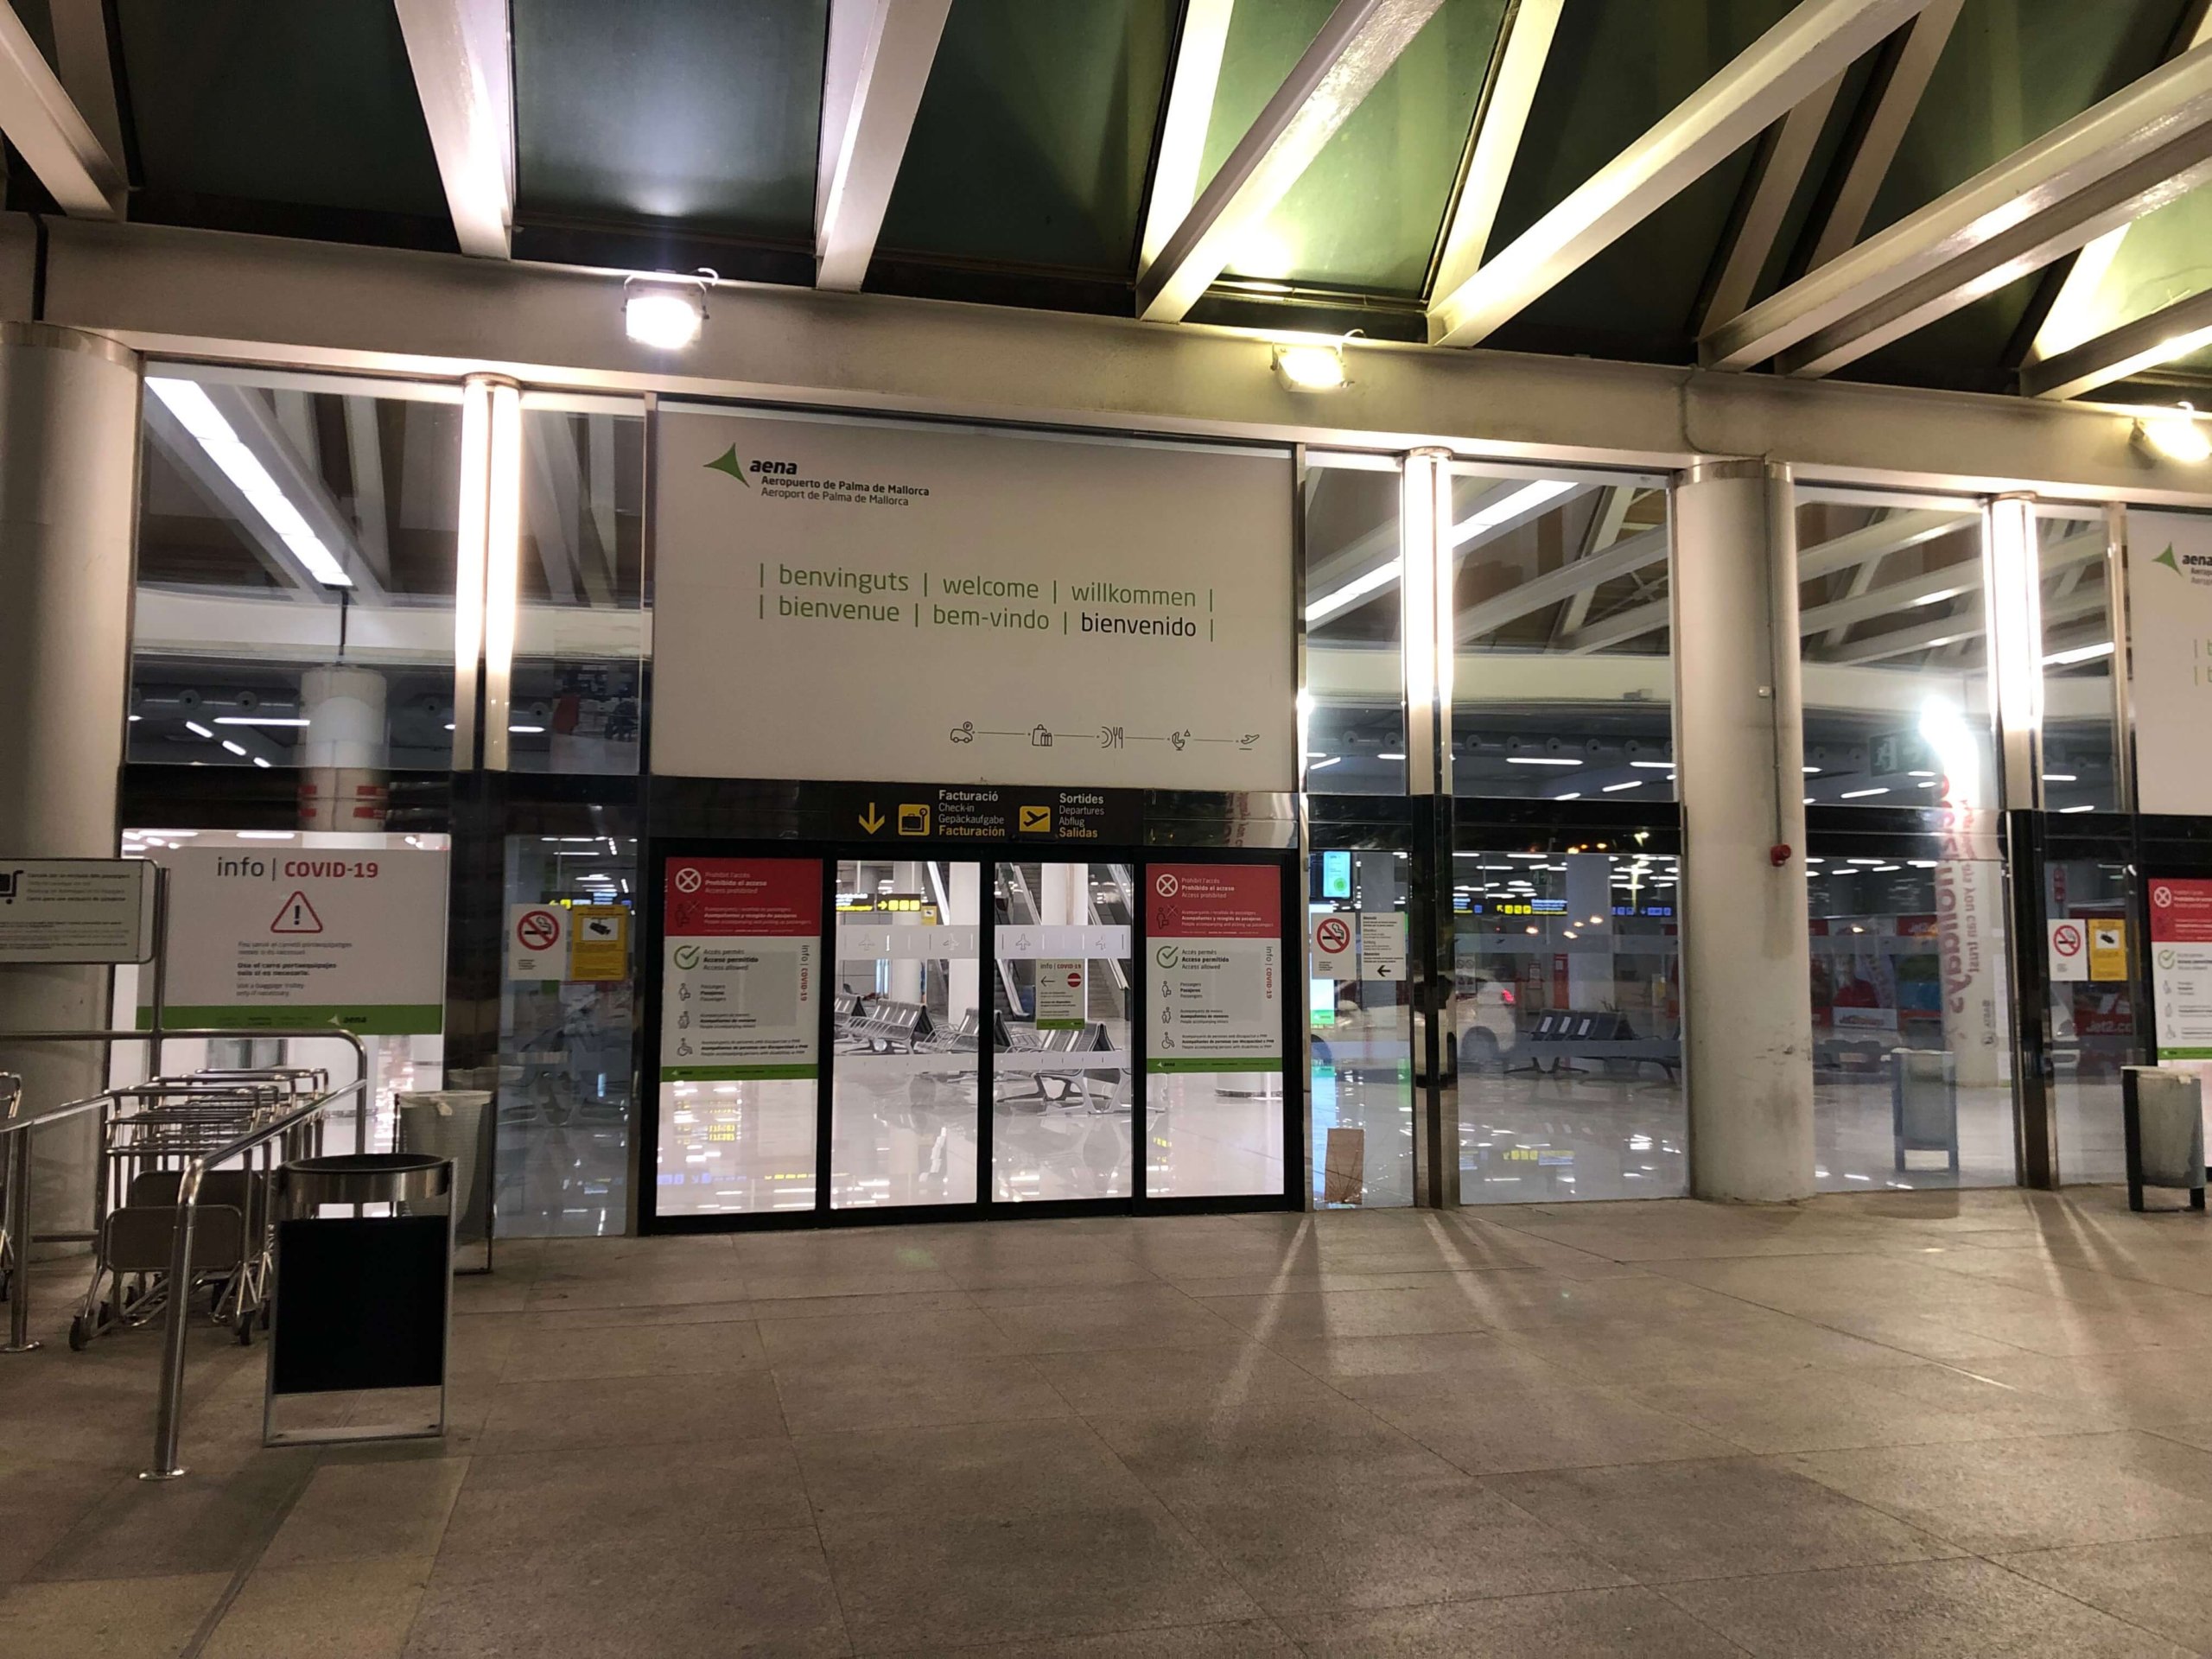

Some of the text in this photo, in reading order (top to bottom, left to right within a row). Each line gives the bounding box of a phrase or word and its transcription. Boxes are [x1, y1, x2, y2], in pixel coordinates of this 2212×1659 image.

[750, 460, 798, 474] aena
[761, 476, 929, 496] Aeropuerto de Palma de Mallorca
[761, 487, 908, 505] Aeroport de Palma de Mallorca
[2182, 554, 2212, 566] aena
[779, 563, 1196, 607] benvinguts welcome willkommen
[779, 595, 1196, 637] bienvenue bem-vindo bienvenido
[938, 789, 999, 802] Facturació
[1059, 793, 1104, 804] Sortides
[938, 803, 975, 812] Check-in
[1058, 805, 1104, 817] Departures
[938, 814, 1004, 825] Gepäckaufgabe
[1058, 817, 1085, 827] Abflug
[938, 824, 1005, 836] Facturación
[1059, 827, 1097, 838] Salidas
[217, 857, 378, 878] info COVID-19
[800, 968, 809, 1001] COVID-19
